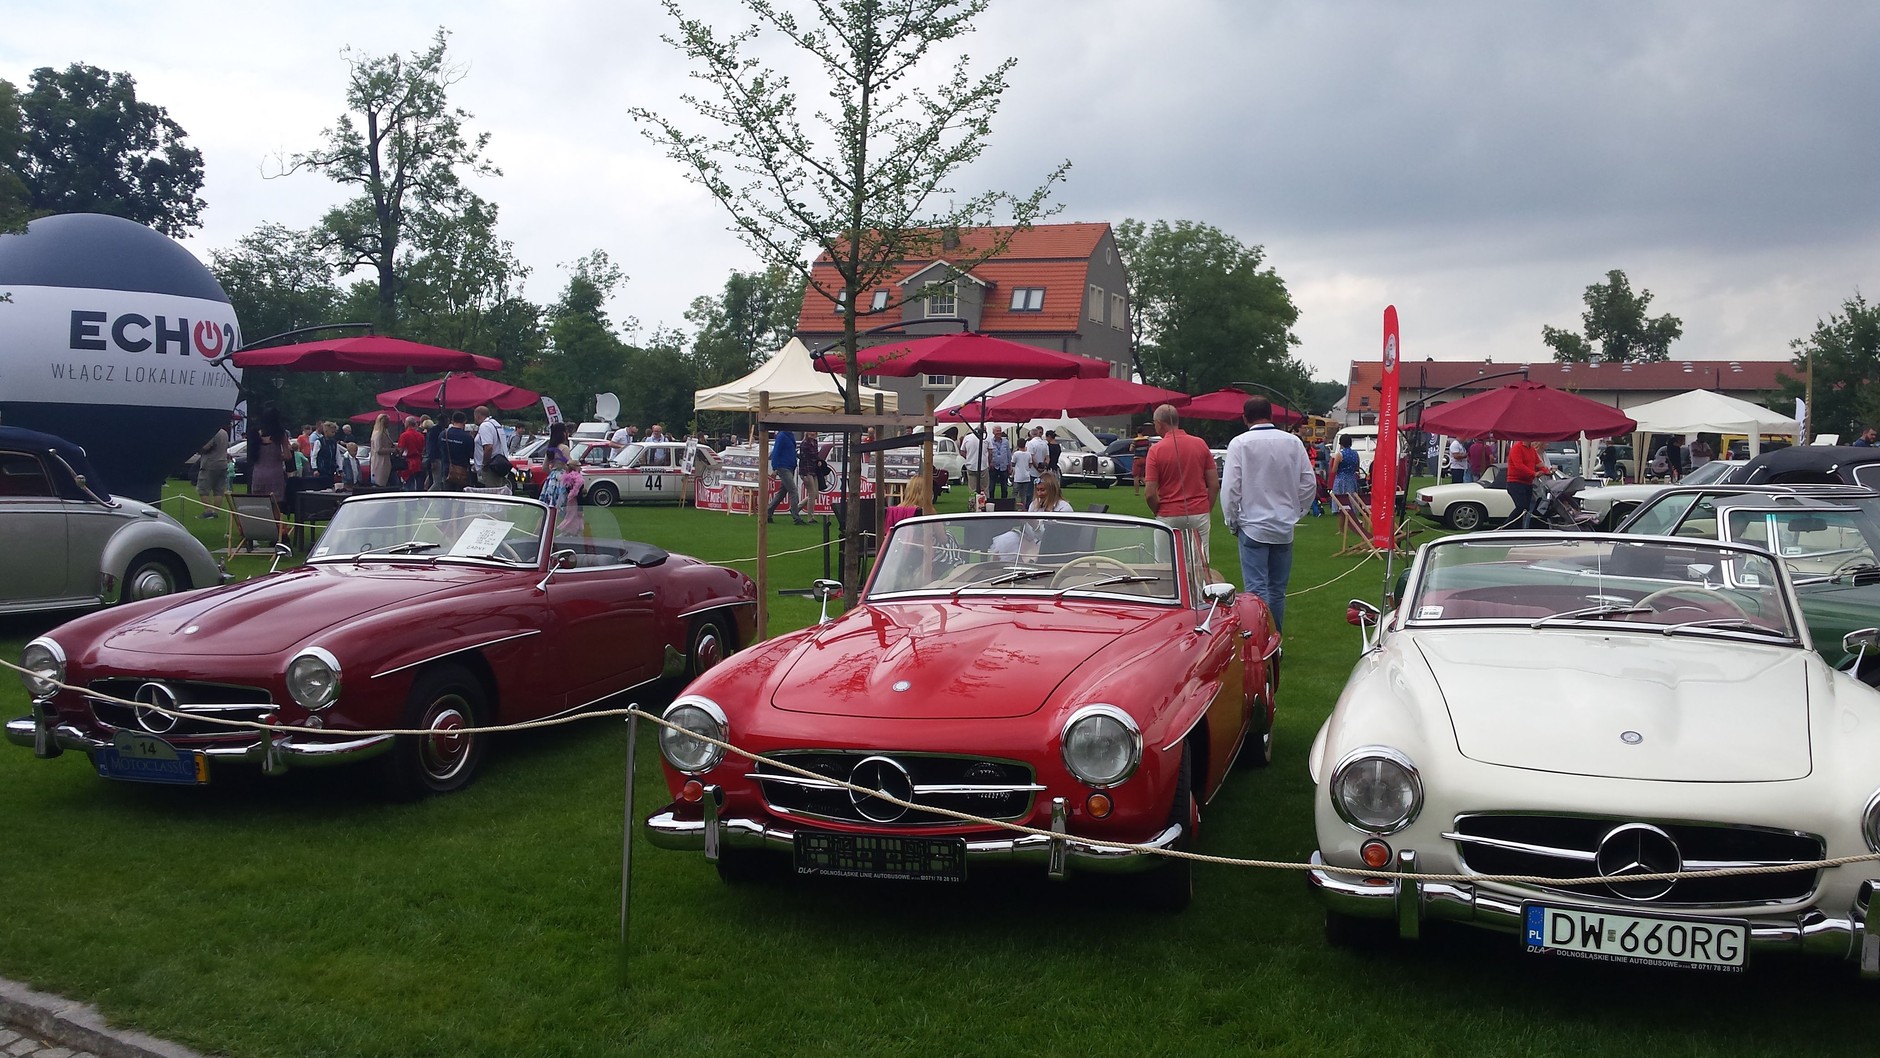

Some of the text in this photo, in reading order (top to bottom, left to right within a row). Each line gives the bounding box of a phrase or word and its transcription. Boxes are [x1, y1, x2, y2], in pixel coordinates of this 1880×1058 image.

[51, 363, 115, 383] WŁĄCZ
[125, 366, 197, 386] LOKALNE
[645, 475, 662, 491] 44
[140, 742, 157, 755] 14
[111, 758, 193, 775] MOTOCLASSIC
[1529, 930, 1541, 940] PL
[1552, 912, 1738, 961] DW 660RG
[1527, 945, 1545, 954] DLA
[1557, 949, 1609, 961] DOLNOŚLĄSKIE
[1629, 957, 1678, 968] AUTOBUSOWE
